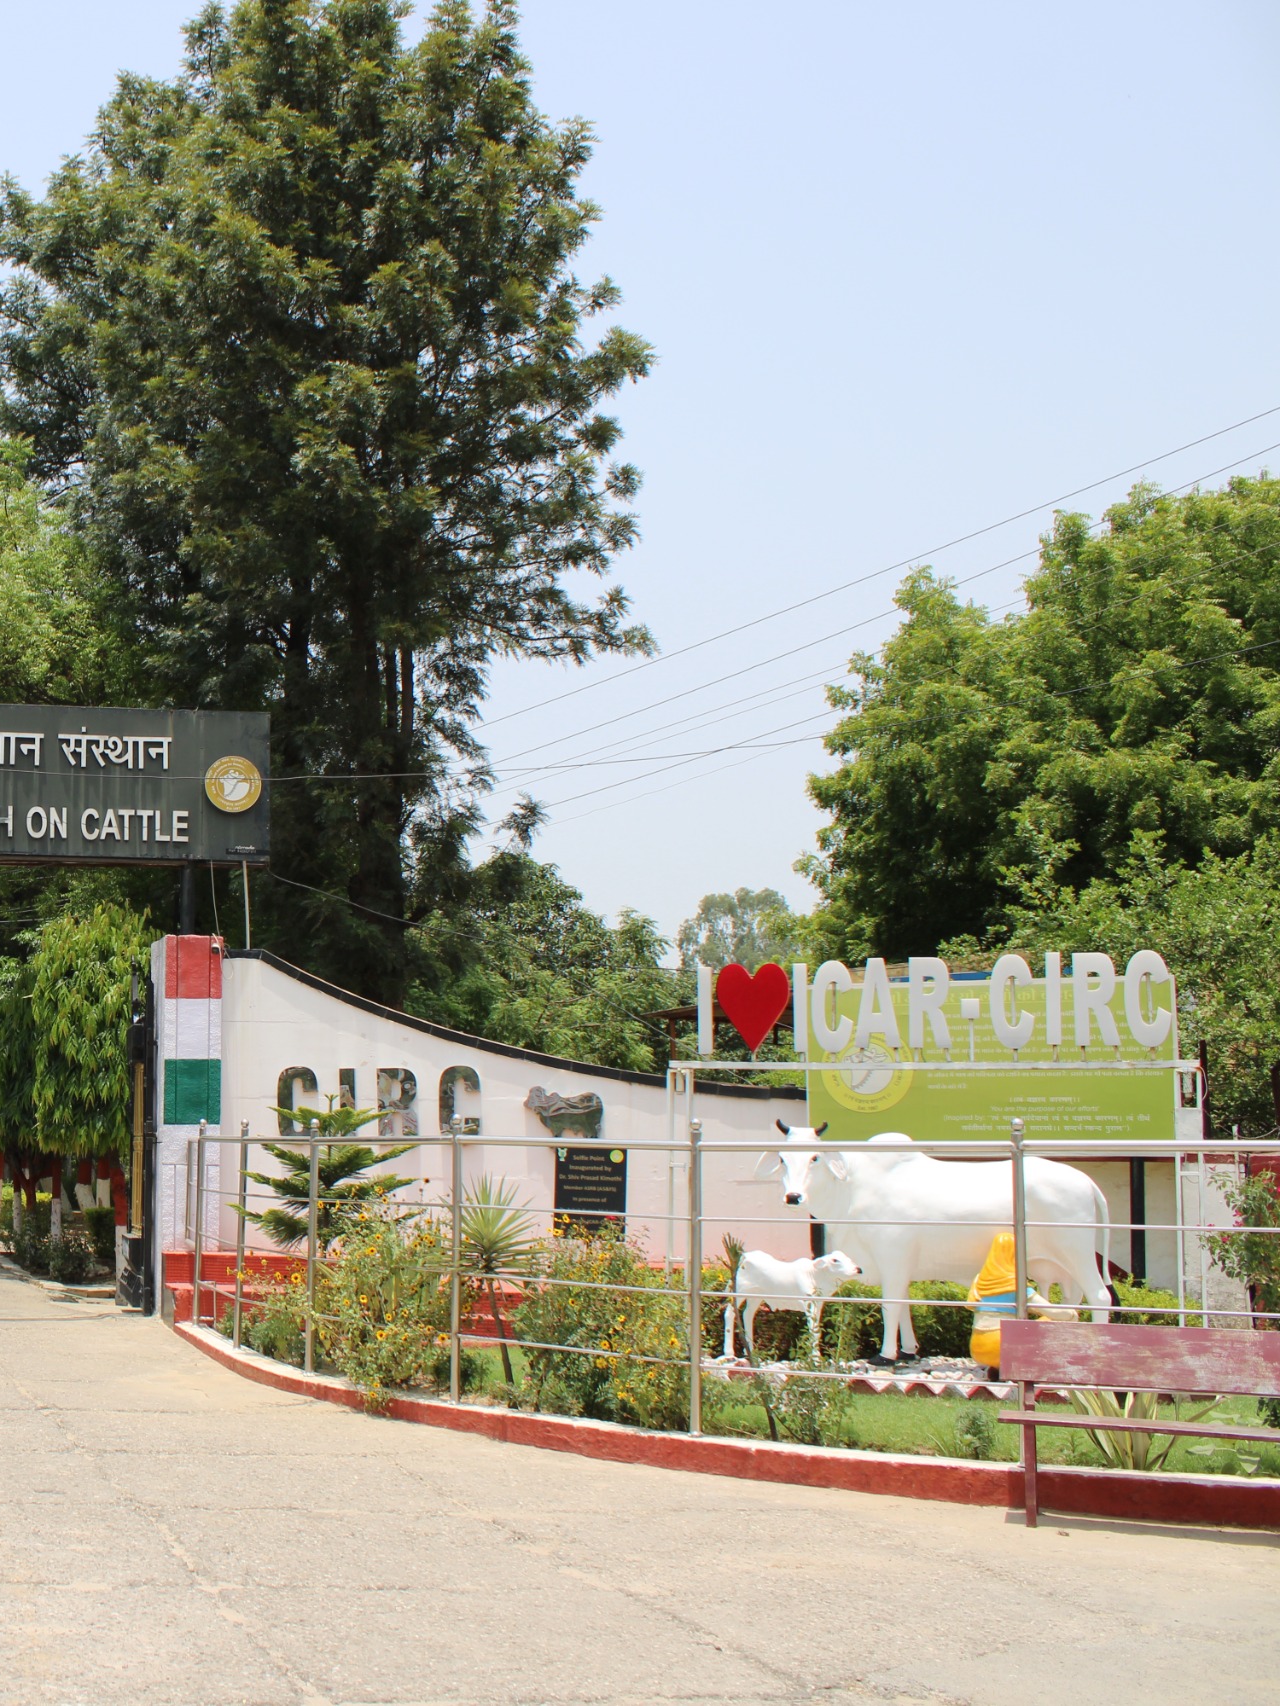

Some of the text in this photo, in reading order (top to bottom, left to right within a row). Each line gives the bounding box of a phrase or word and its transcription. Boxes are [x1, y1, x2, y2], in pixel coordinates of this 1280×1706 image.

[58, 726, 172, 770] संस्थान
[26, 806, 68, 839] ON
[81, 808, 189, 843] CATTLE
[697, 950, 1172, 1055] I ICAR-CIRC
[277, 1065, 482, 1137] CIRC
